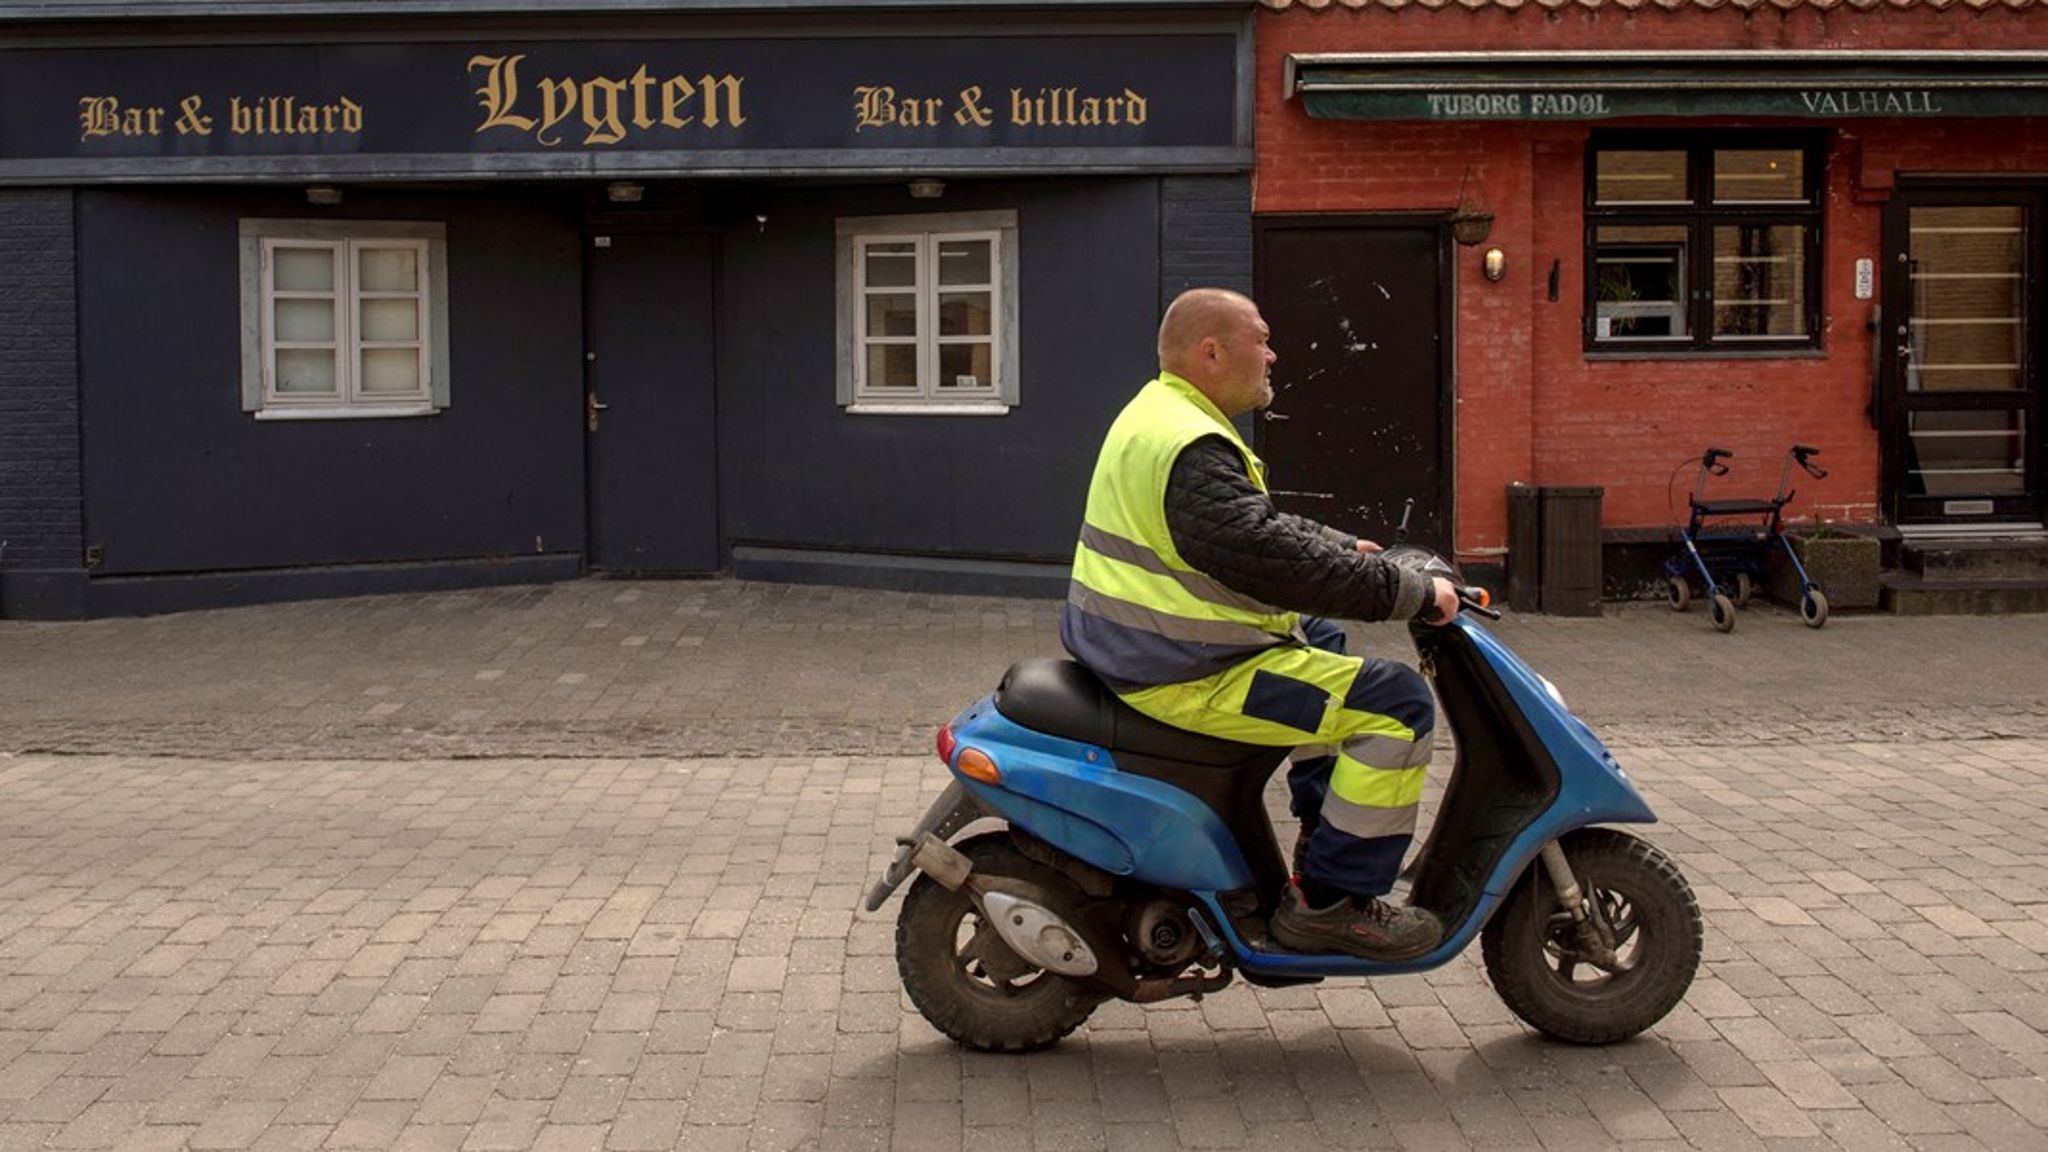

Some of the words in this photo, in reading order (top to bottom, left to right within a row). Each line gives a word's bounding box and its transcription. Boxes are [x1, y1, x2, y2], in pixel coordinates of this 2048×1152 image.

[79, 96, 165, 142] Bar
[175, 95, 213, 135] &
[230, 96, 363, 134] billard
[467, 55, 747, 146] Lygten
[853, 85, 943, 133] Bar
[953, 85, 993, 127] &
[1010, 87, 1148, 126] billard
[1427, 93, 1521, 115] TUBORG
[1800, 91, 1942, 113] VALHALL
